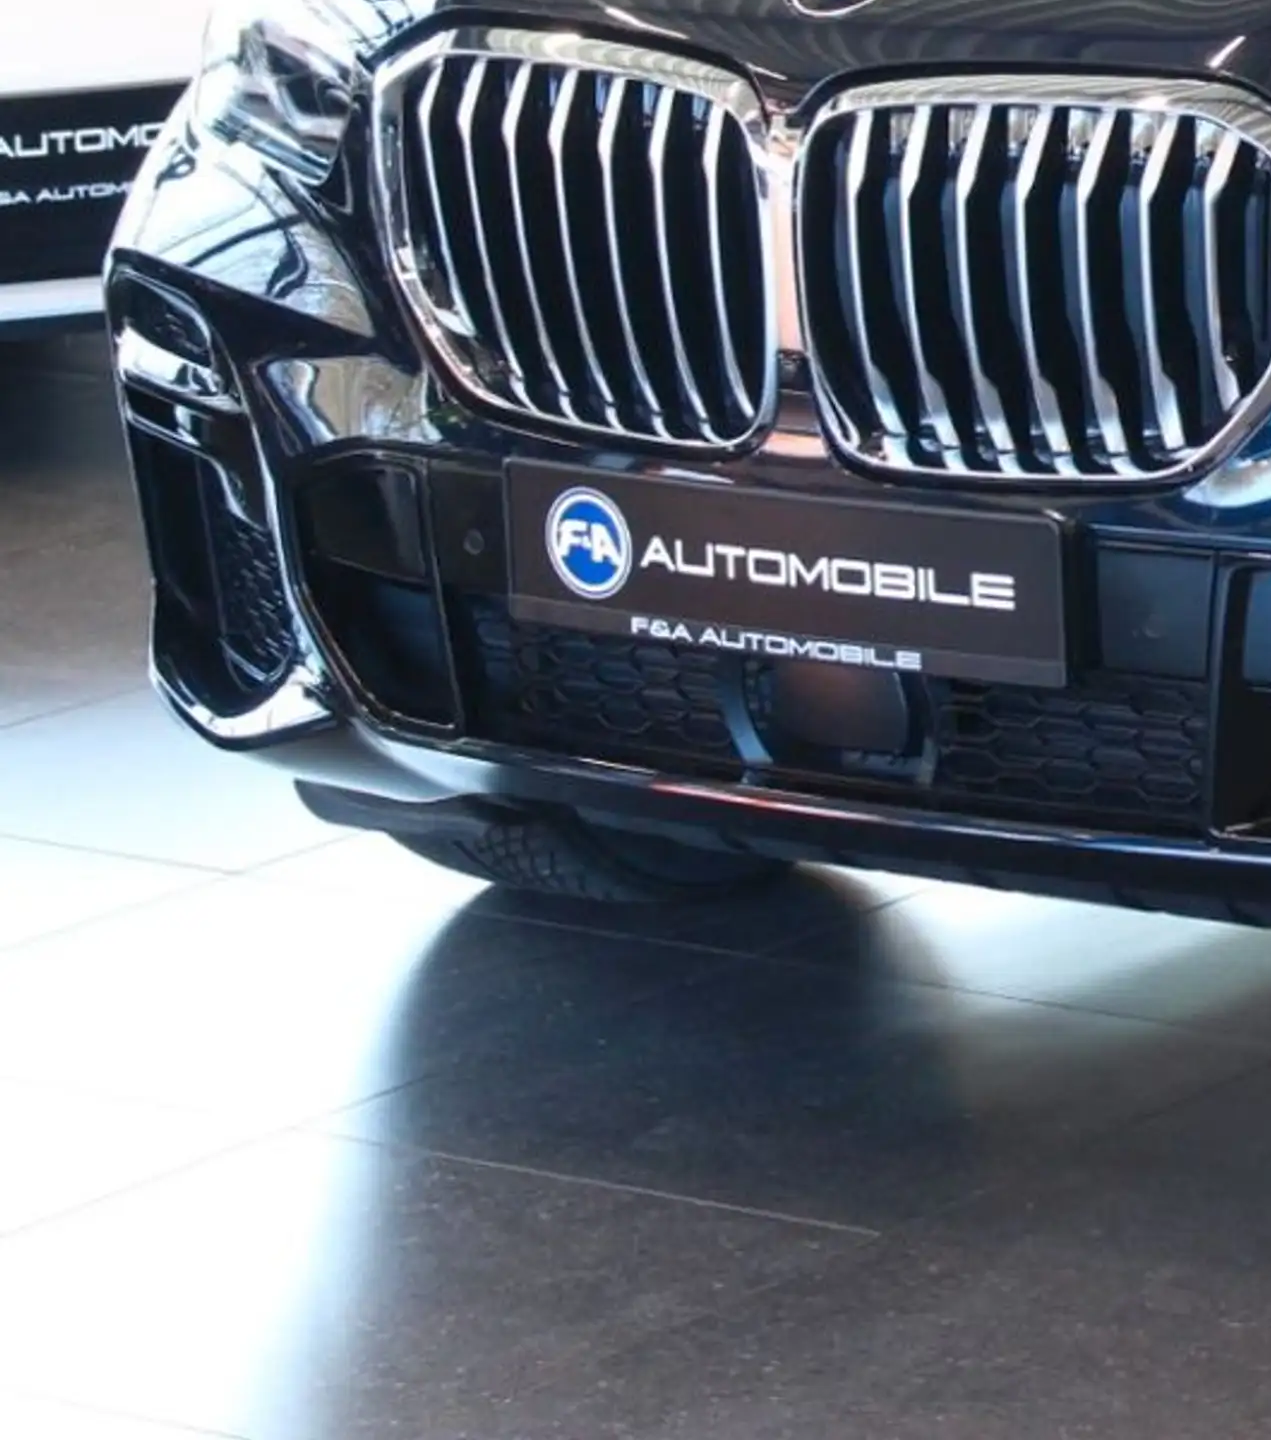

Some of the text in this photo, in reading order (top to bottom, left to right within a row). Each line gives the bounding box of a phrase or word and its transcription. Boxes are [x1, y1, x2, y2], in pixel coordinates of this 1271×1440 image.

[640, 536, 1015, 610] AUTOMOBILE
[631, 616, 922, 671] F&A AUTOMOBILE
